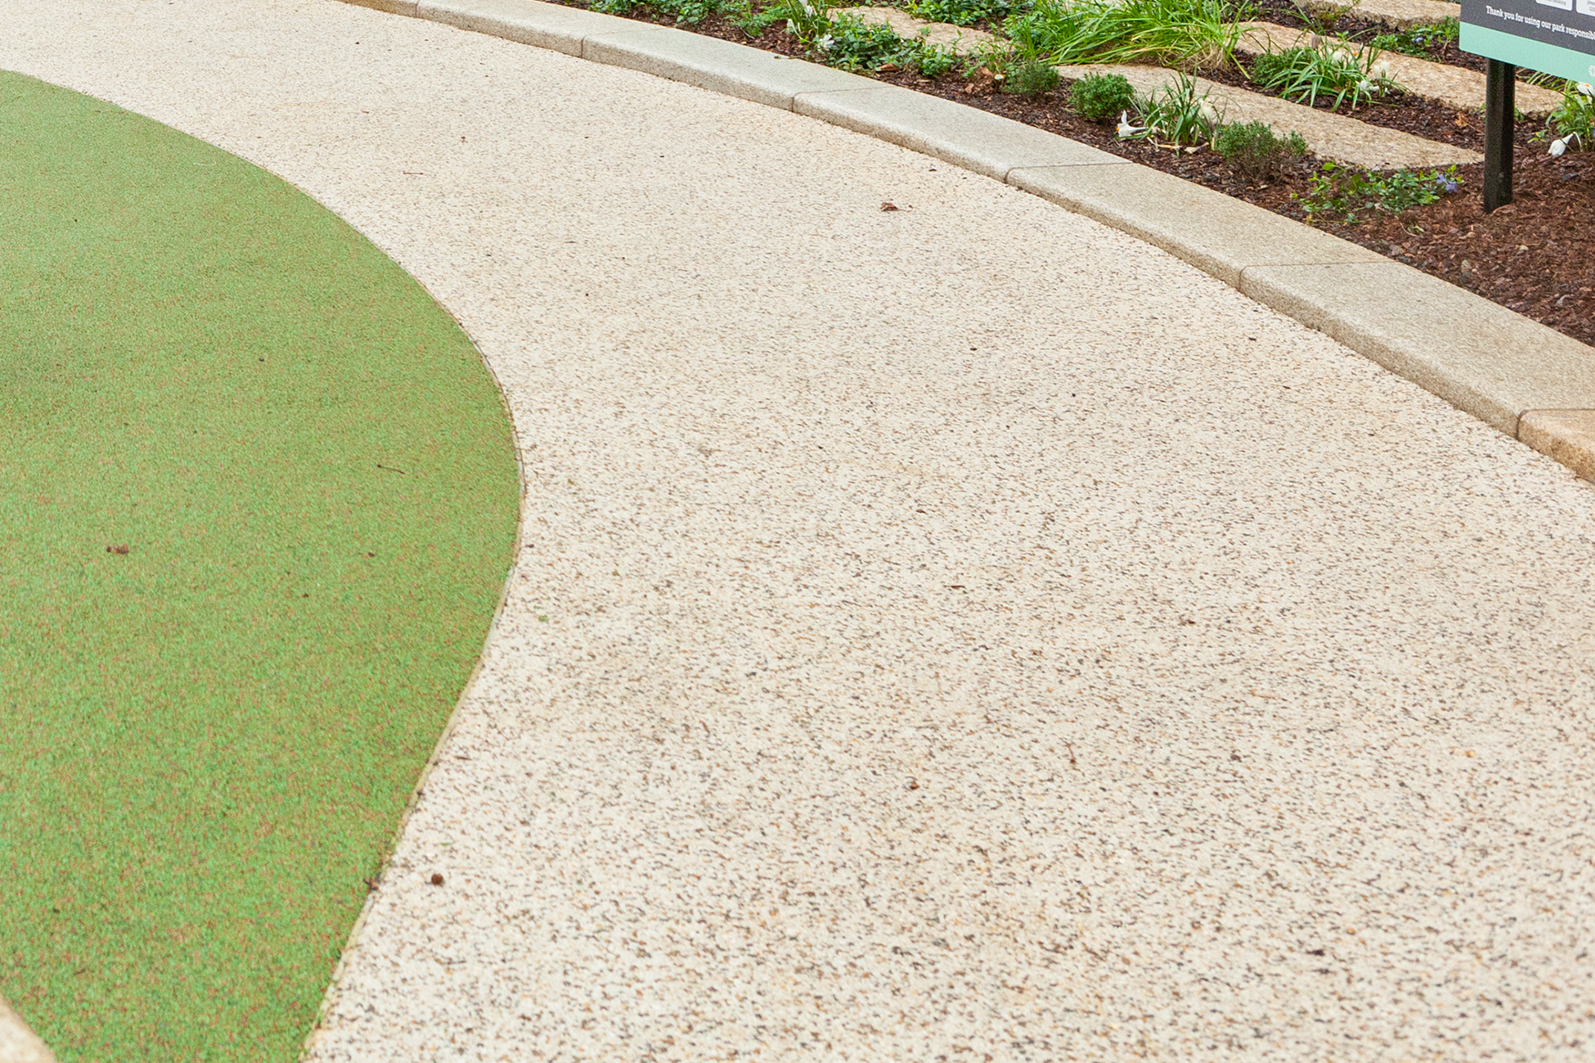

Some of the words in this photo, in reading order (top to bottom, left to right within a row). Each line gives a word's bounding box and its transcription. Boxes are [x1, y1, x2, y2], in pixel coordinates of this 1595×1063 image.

[1486, 5, 1504, 18] Thank
[1504, 10, 1515, 20] you
[1515, 12, 1524, 22] for
[1524, 16, 1541, 28] using
[1541, 20, 1552, 29] our
[1552, 23, 1565, 33] park
